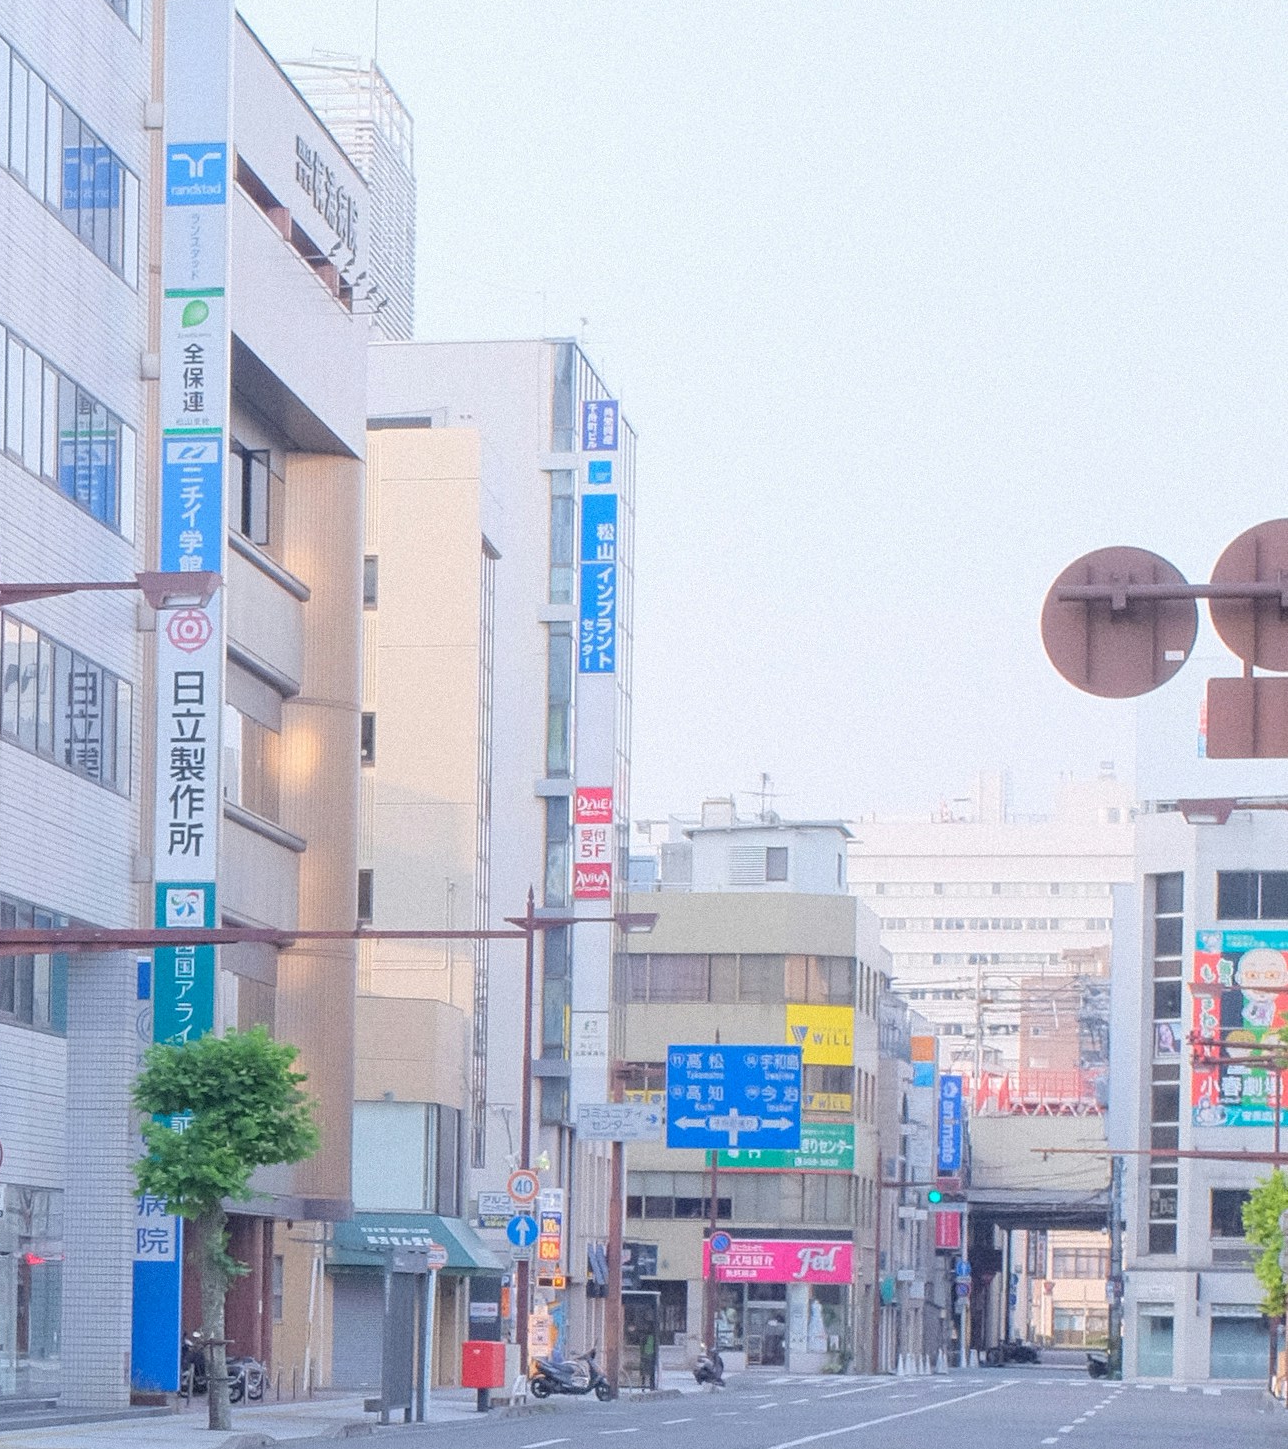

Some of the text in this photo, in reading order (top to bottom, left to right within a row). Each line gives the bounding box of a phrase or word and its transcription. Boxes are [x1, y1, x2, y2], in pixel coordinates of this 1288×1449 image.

[171, 182, 222, 195] randstad
[182, 342, 205, 414] 全保連
[179, 466, 204, 571] ニチイ学館
[168, 670, 206, 857] 日立製作所
[580, 829, 606, 843] 受付
[581, 843, 606, 858] 5F
[813, 1033, 851, 1046] WILL
[686, 1053, 725, 1069] 高松
[760, 1053, 800, 1071] 宇和島
[685, 1085, 724, 1101] 高知
[761, 1084, 799, 1102] 今治
[592, 1120, 635, 1131] センター
[514, 1179, 533, 1194] 40
